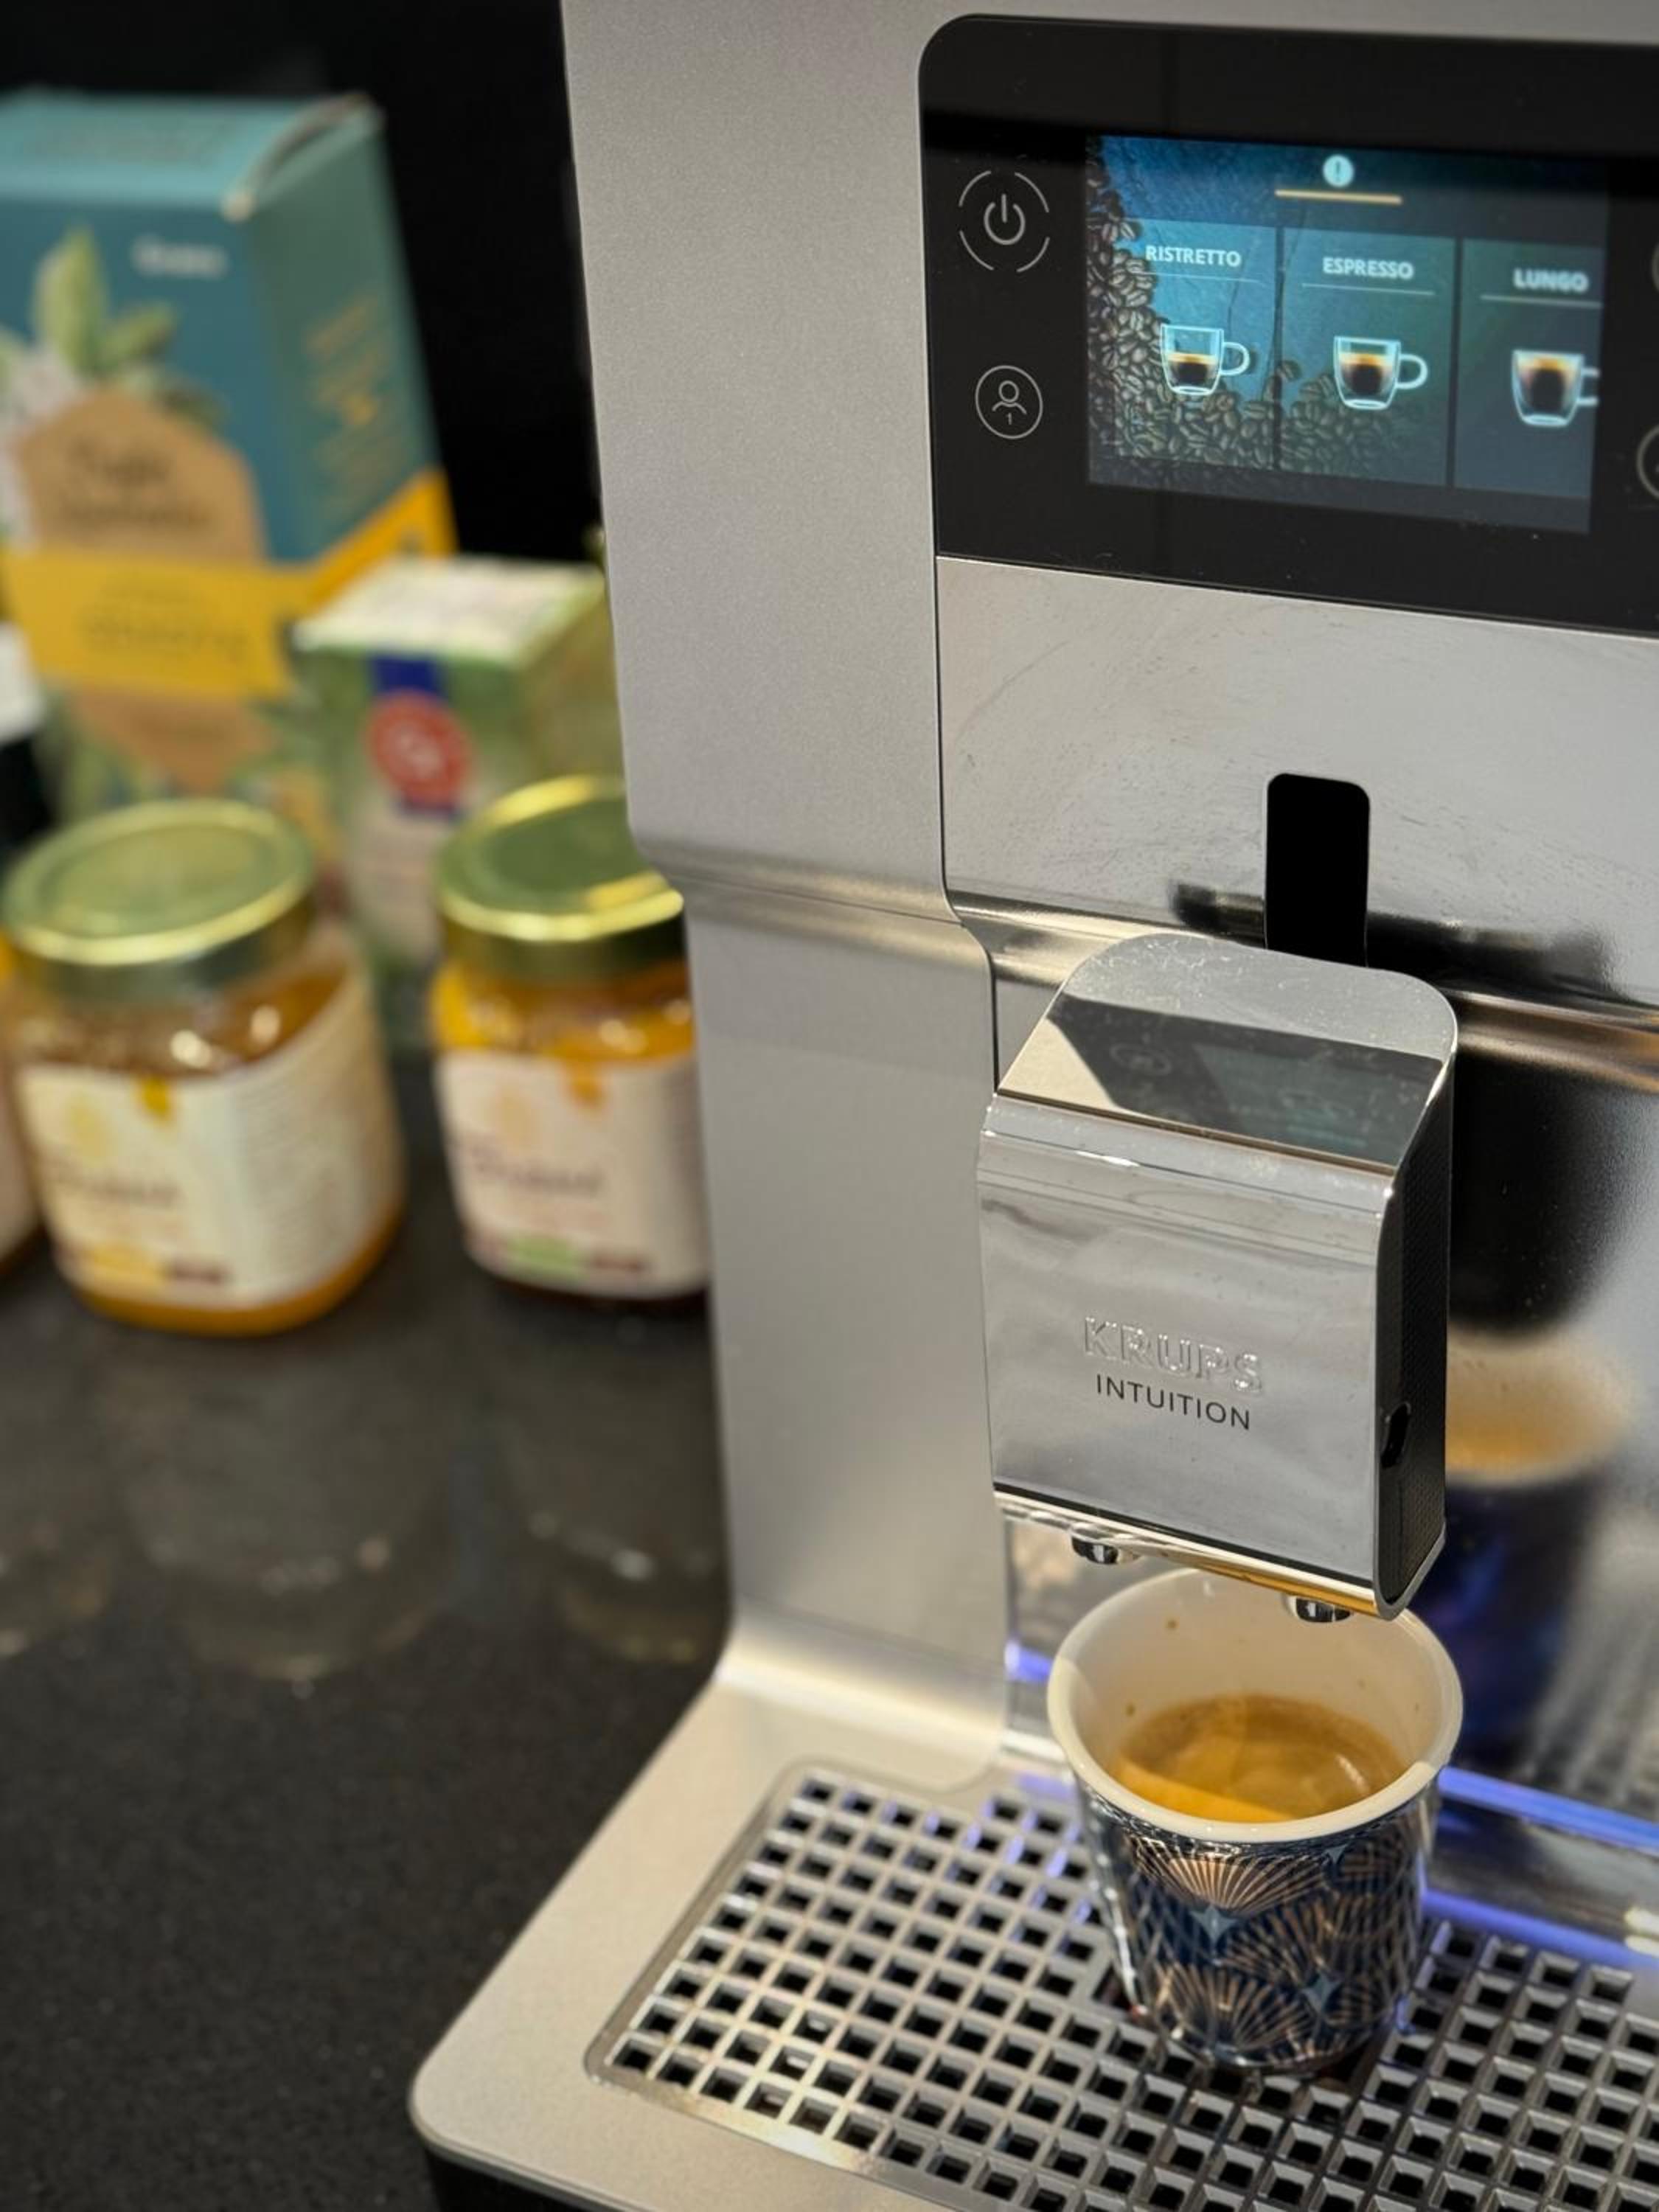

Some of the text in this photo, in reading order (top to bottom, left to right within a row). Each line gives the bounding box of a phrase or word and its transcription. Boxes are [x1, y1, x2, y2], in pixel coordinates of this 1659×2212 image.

[1145, 245, 1242, 267] RISTRETTO
[1323, 257, 1415, 280] ESPRESSO
[1513, 268, 1589, 292] LUNGO
[1005, 412, 1012, 425] 1
[1085, 1316, 1262, 1393] KRUPS
[1096, 1374, 1250, 1430] INTUITION
